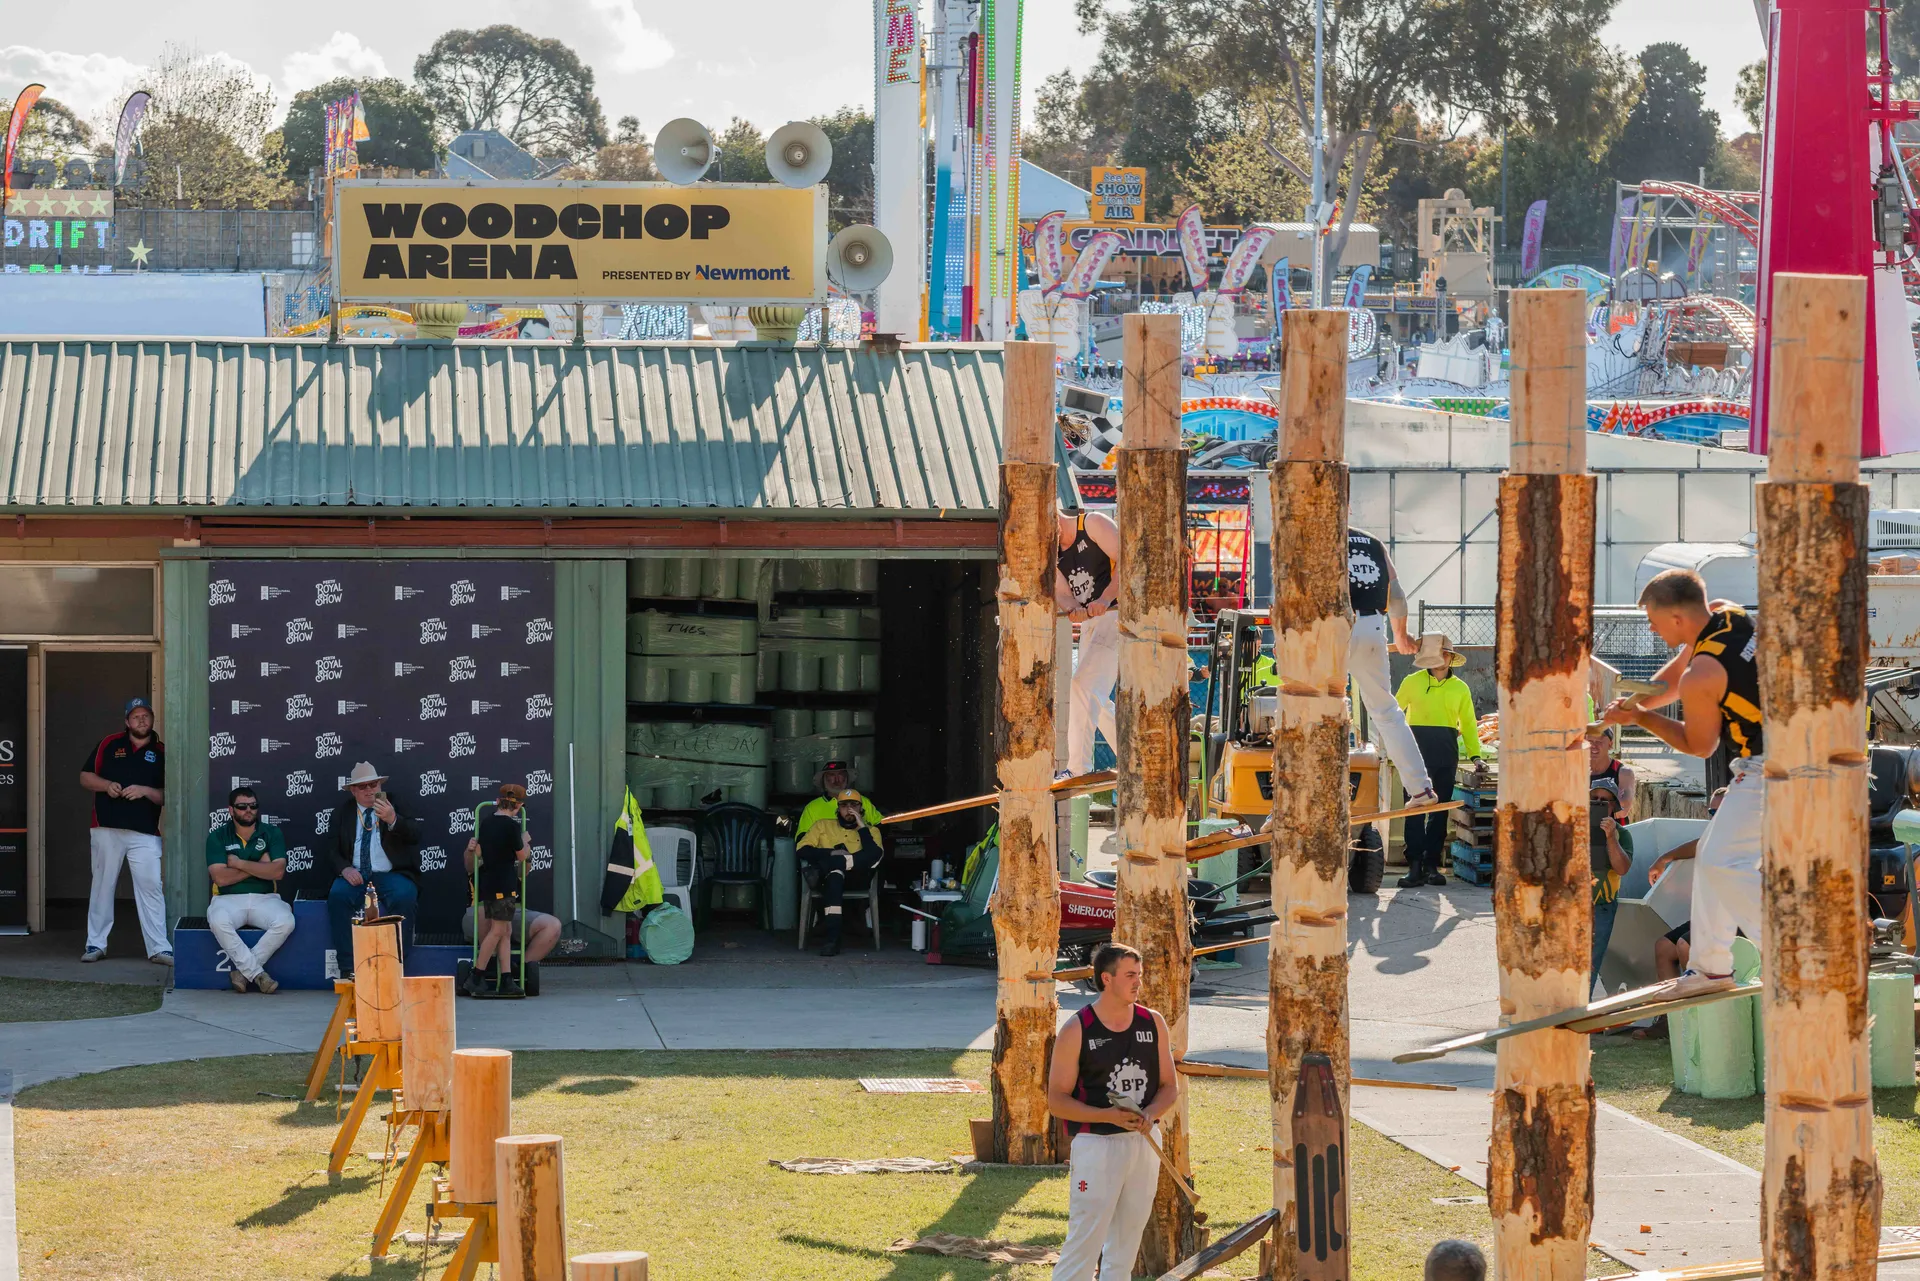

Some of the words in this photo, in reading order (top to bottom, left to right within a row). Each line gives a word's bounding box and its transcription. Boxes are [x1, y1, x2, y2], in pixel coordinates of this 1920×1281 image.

[1095, 183, 1141, 195] SHOW
[1105, 206, 1133, 218] AIR
[363, 203, 730, 240] WOODCHOP
[4, 220, 110, 248] DRIFT
[363, 244, 578, 280] ARENA
[602, 271, 673, 281] PRESENTED
[675, 271, 691, 281] BY
[695, 264, 791, 281] Newmont
[1076, 539, 1089, 554] WA
[1352, 564, 1376, 574] BTP
[209, 583, 236, 596] ROYAL
[315, 583, 342, 596] ROYAL
[449, 583, 476, 596] ROYAL
[209, 593, 236, 606] SHOW
[315, 593, 342, 606] SHOW
[449, 593, 476, 606] SHOW
[286, 621, 313, 634] ROYAL
[420, 621, 447, 634] ROYAL
[526, 621, 553, 634] ROYAL
[286, 631, 313, 644] SHOW
[420, 631, 447, 644] SHOW
[526, 631, 553, 644] SHOW
[209, 659, 236, 672] ROYAL
[315, 659, 342, 672] ROYAL
[449, 659, 476, 672] ROYAL
[209, 669, 236, 682] SHOW
[315, 669, 342, 682] SHOW
[449, 669, 476, 682] SHOW
[286, 697, 313, 710] ROYAL
[420, 697, 447, 710] ROYAL
[526, 697, 553, 710] ROYAL
[286, 707, 313, 720] SHOW
[420, 707, 447, 720] SHOW
[526, 707, 553, 720] SHOW
[209, 735, 236, 748] ROYAL
[315, 735, 342, 748] ROYAL
[449, 735, 476, 748] ROYAL
[209, 745, 236, 758] SHOW
[315, 745, 342, 758] SHOW
[449, 745, 476, 758] SHOW
[286, 773, 313, 786] ROYAL
[420, 773, 447, 786] ROYAL
[526, 773, 553, 786] ROYAL
[286, 783, 313, 796] SHOW
[420, 783, 447, 796] SHOW
[526, 783, 553, 796] SHOW
[209, 811, 232, 825] ROYA
[449, 811, 475, 825] ROYAL
[315, 822, 330, 835] SH
[449, 822, 475, 835] SHOW
[286, 849, 313, 862] ROYAL
[420, 849, 447, 862] ROYAL
[286, 859, 313, 872] SHOW
[420, 859, 447, 872] SHOW
[1068, 903, 1115, 920] SHERLOCK
[215, 949, 232, 972] 2
